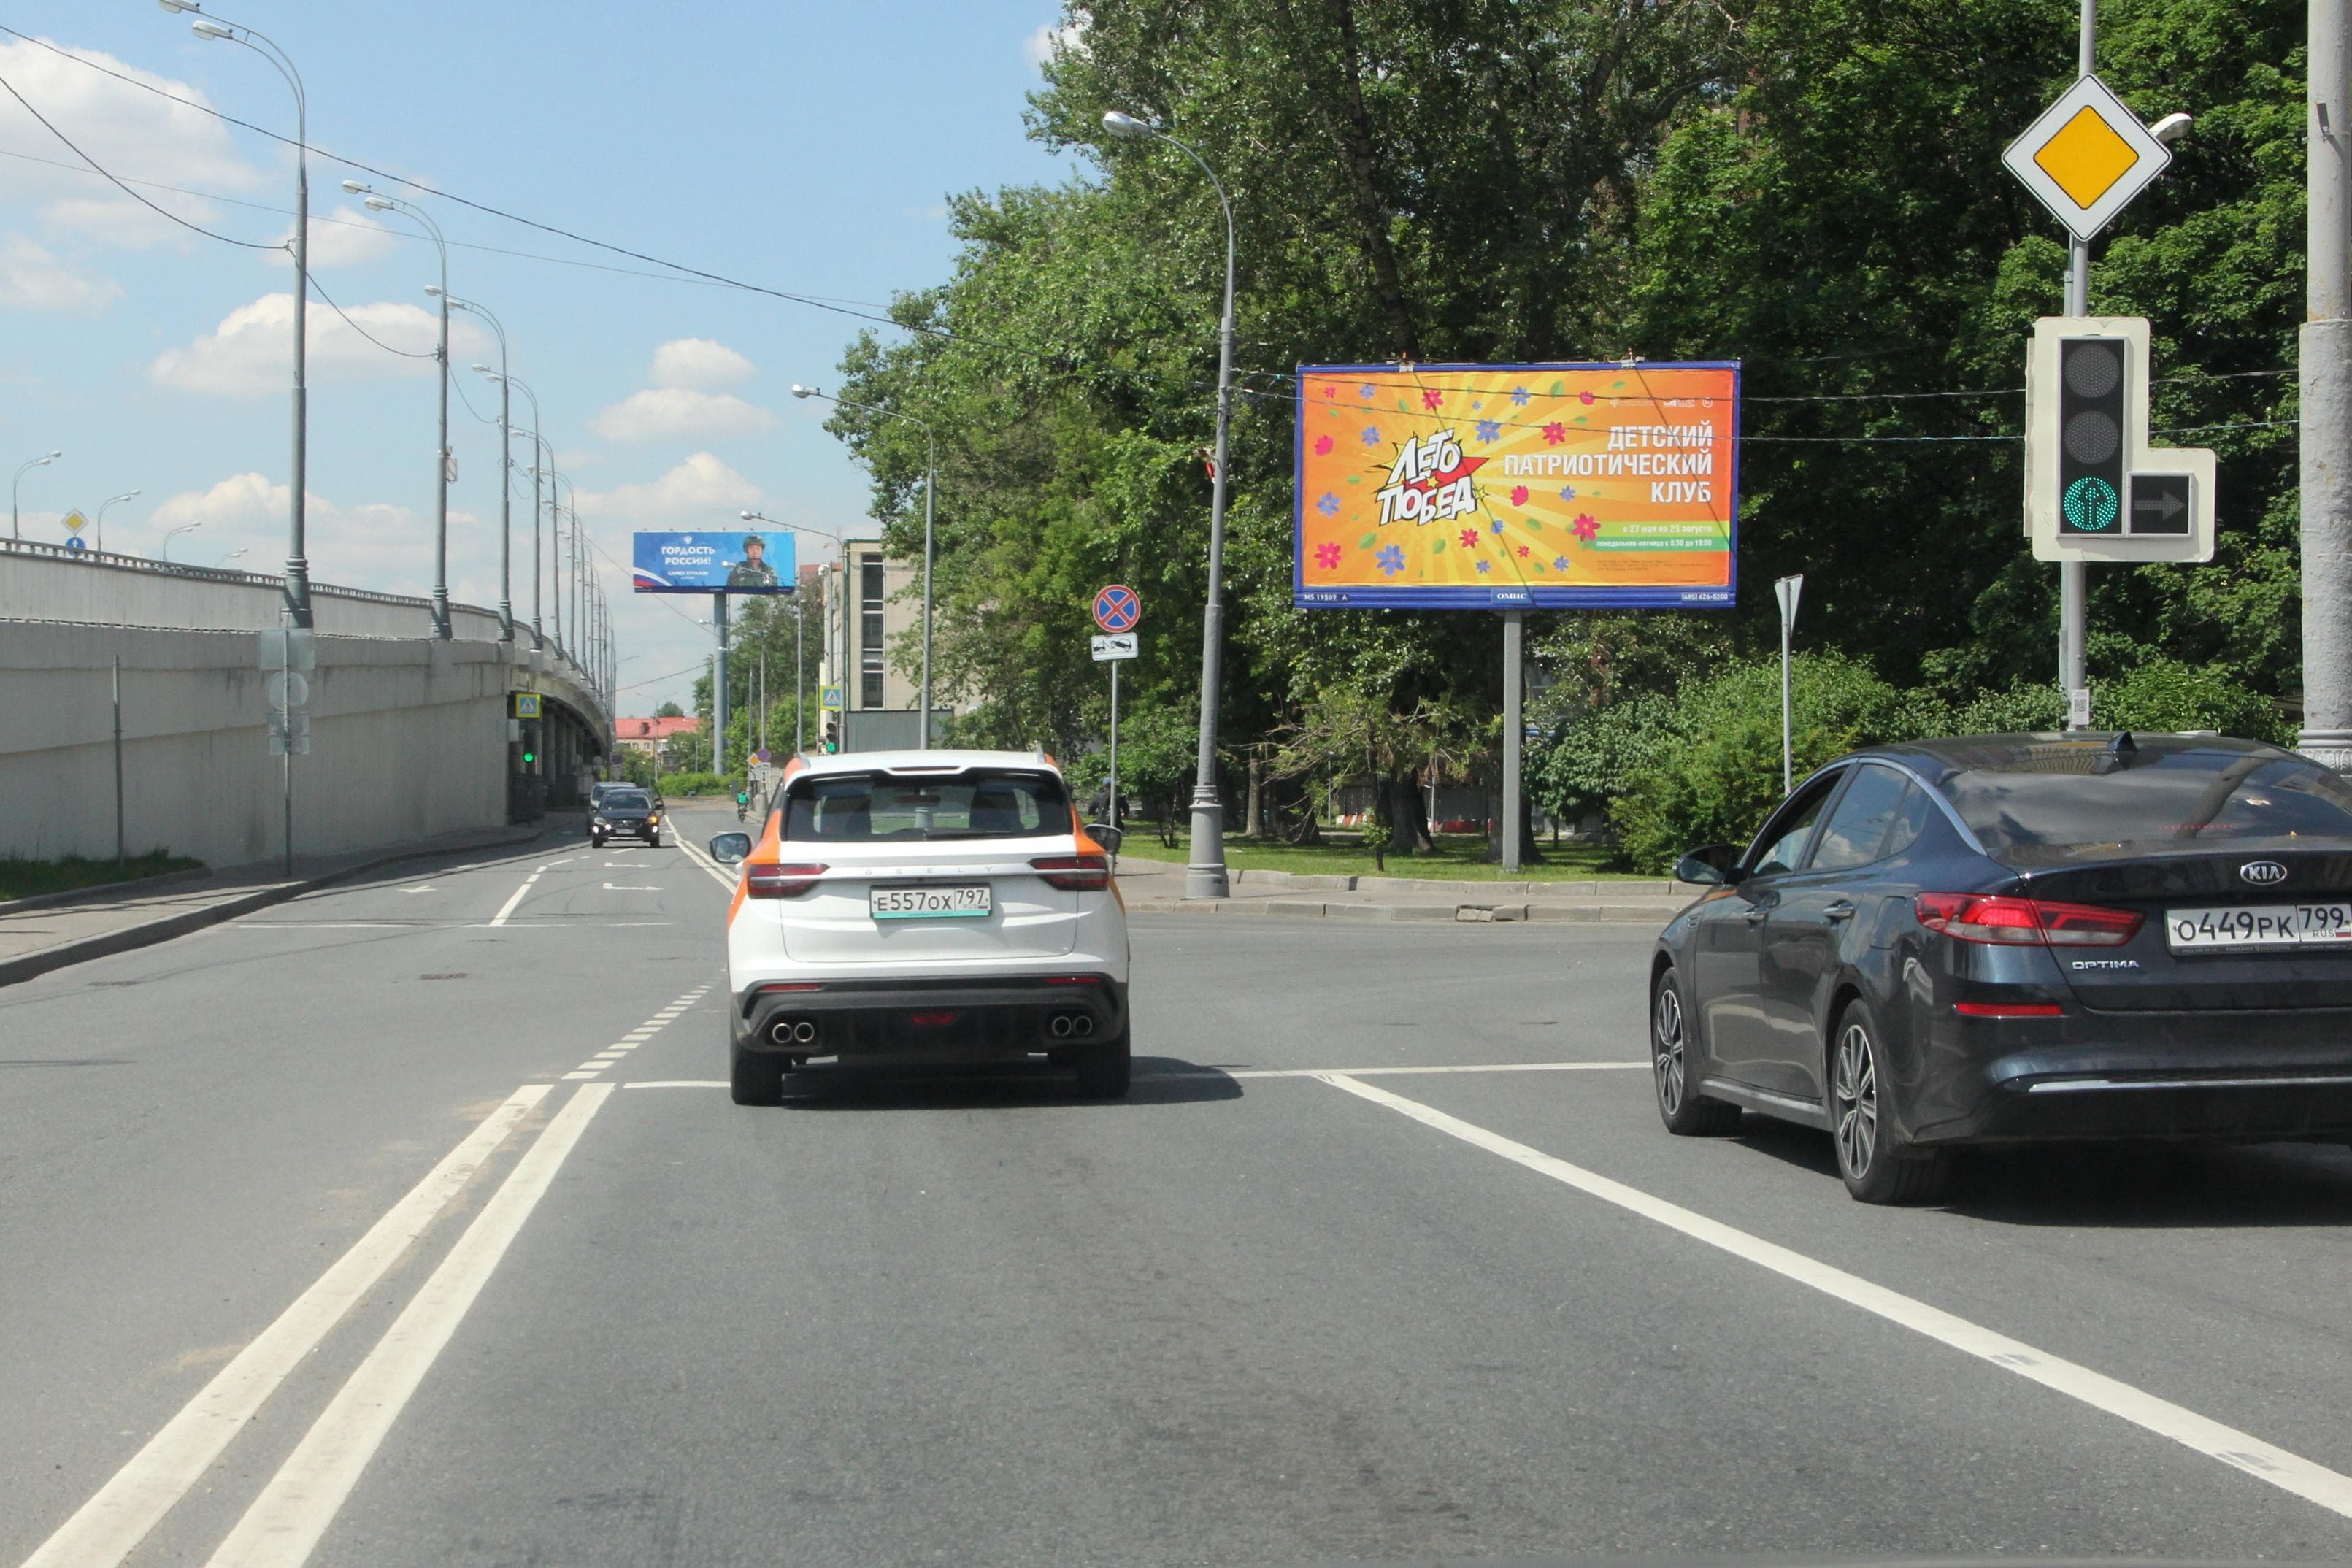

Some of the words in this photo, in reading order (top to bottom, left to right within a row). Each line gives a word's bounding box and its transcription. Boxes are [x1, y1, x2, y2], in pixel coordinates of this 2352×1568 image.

[1607, 420, 1713, 451] ДЕТСКИЙ
[1387, 428, 1461, 485] ЛЕТО
[1504, 448, 1712, 475] ПАТРИОТИЧЕСКИЙ
[1376, 476, 1476, 526] ПОБЕД
[1651, 481, 1711, 503] КЛУБ
[1629, 525, 1640, 533] 27
[1669, 525, 1680, 533] 23
[1681, 526, 1713, 534] августа
[661, 546, 715, 555] ГОРДОСТЬ
[665, 557, 712, 565] РОССИИ!
[865, 866, 994, 875] GEELY
[2248, 865, 2282, 880] KIA
[877, 891, 951, 912] Е557ОХ
[956, 889, 985, 904] 797
[2178, 911, 2294, 942] О449РК
[2299, 907, 2344, 929] 799
[2313, 929, 2334, 938] RUS
[2072, 959, 2140, 969] OPTIMA
